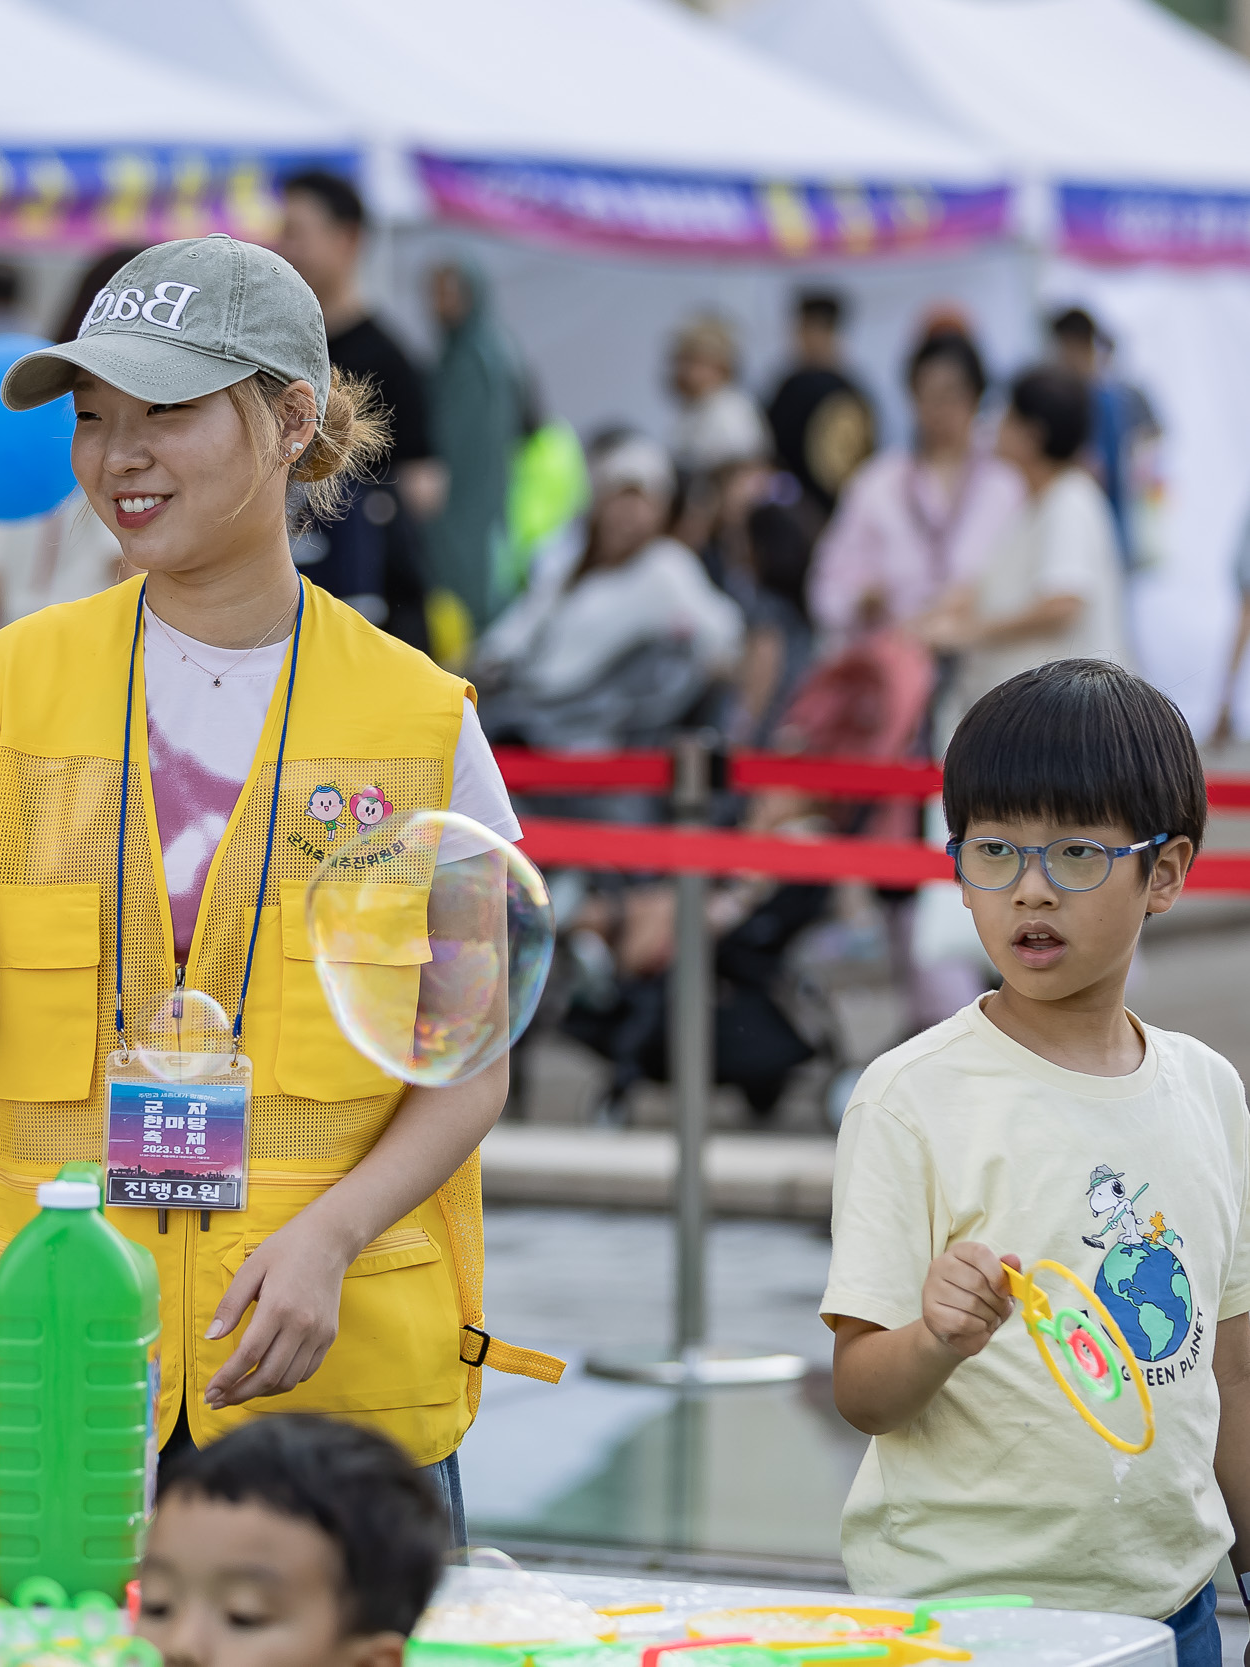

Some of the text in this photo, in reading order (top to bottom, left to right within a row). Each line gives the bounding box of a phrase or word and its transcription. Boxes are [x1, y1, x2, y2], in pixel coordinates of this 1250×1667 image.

[143, 1115, 208, 1131] 한마당
[124, 1182, 220, 1202] 진행요원
[1121, 1306, 1204, 1387] GEEN PLANET
